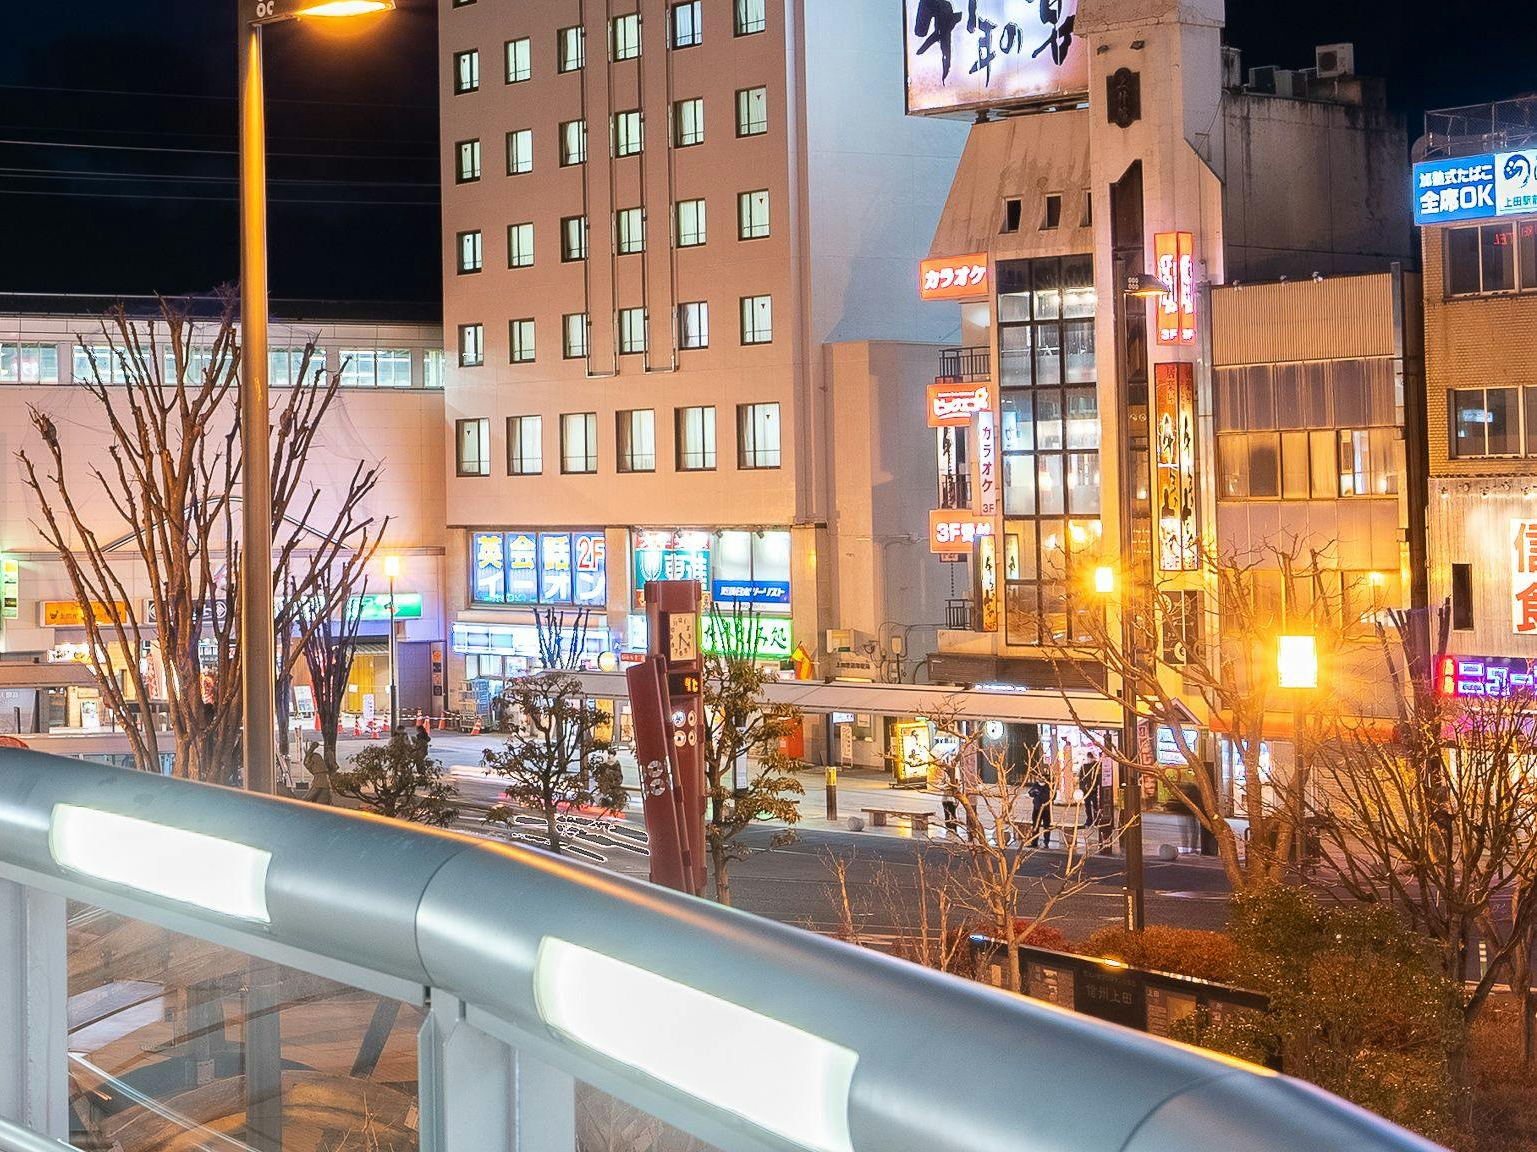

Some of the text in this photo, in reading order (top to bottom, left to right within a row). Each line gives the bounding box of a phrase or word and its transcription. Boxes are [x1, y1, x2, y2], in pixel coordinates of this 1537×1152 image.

[1419, 164, 1493, 188] 加熱式たばこ
[1420, 184, 1494, 214] 全席OK
[924, 265, 987, 290] カラオケ
[982, 426, 993, 493] カラオケ
[982, 503, 994, 513] 3F
[477, 535, 570, 570] 英会話
[578, 536, 606, 570] 2F
[477, 570, 606, 600] イーオン
